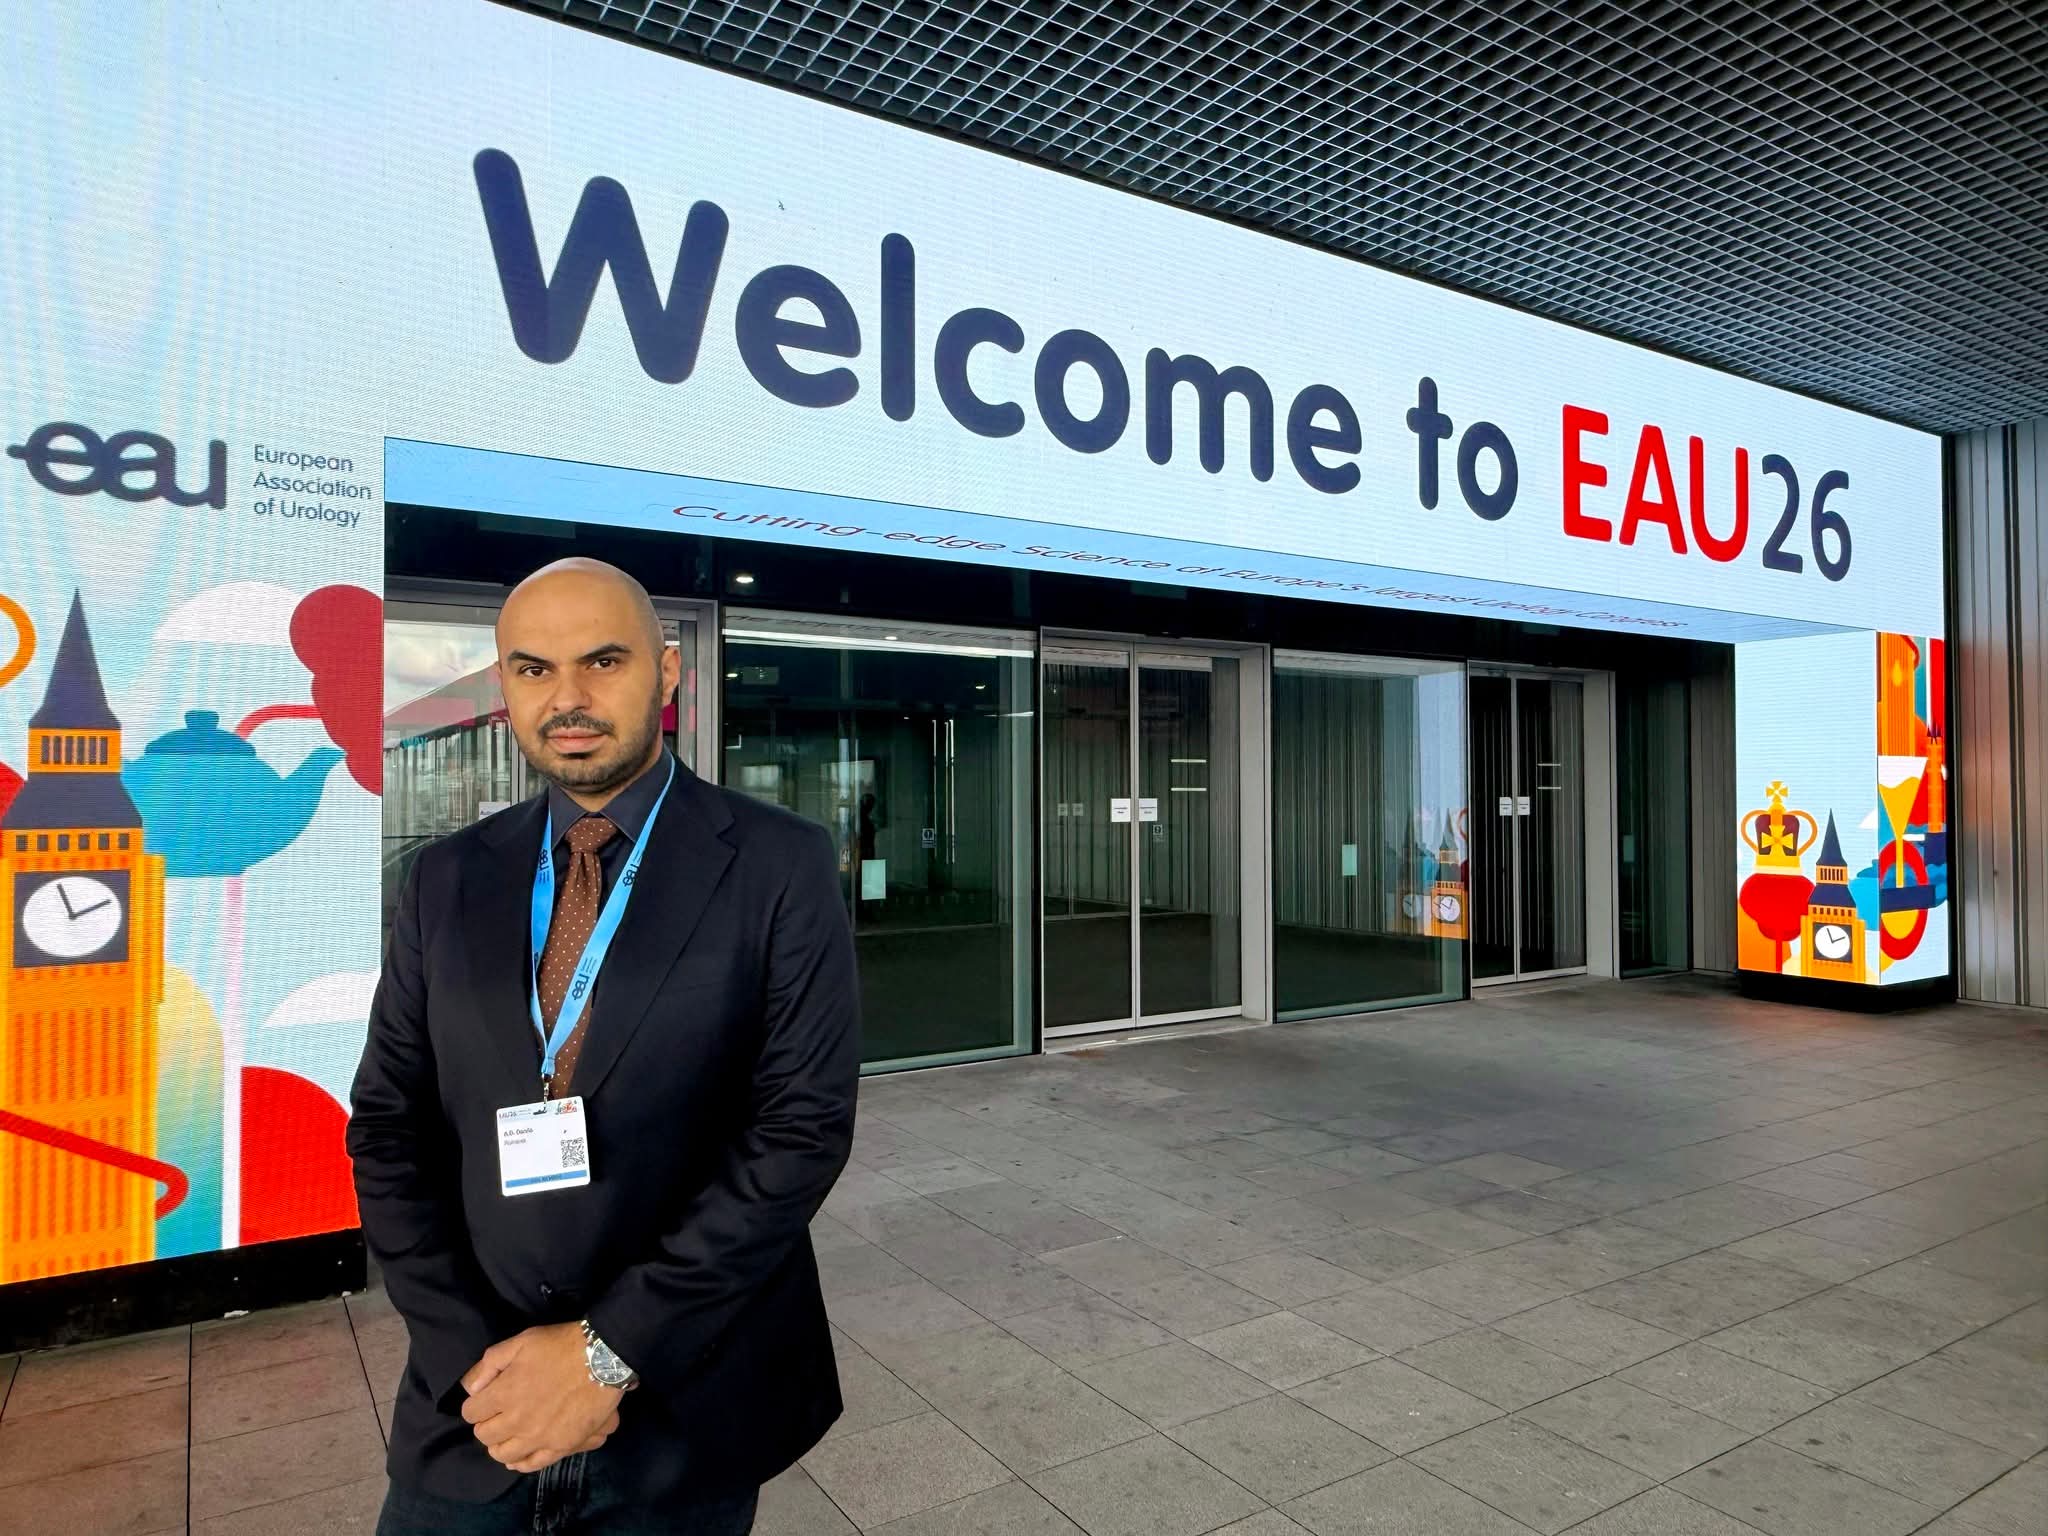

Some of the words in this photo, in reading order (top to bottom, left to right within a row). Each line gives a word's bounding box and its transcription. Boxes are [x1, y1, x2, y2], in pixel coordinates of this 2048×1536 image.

[473, 147, 1362, 495] Welcome
[1406, 376, 1519, 521] to
[1562, 403, 1852, 582] EAU26
[7, 421, 228, 510] eau
[254, 443, 354, 472] European
[253, 471, 372, 500] Association
[253, 497, 276, 515] of
[280, 499, 361, 528] Urology
[673, 505, 1007, 551] Cutting-edge
[1011, 545, 1171, 569] Science
[1175, 565, 1226, 575] at
